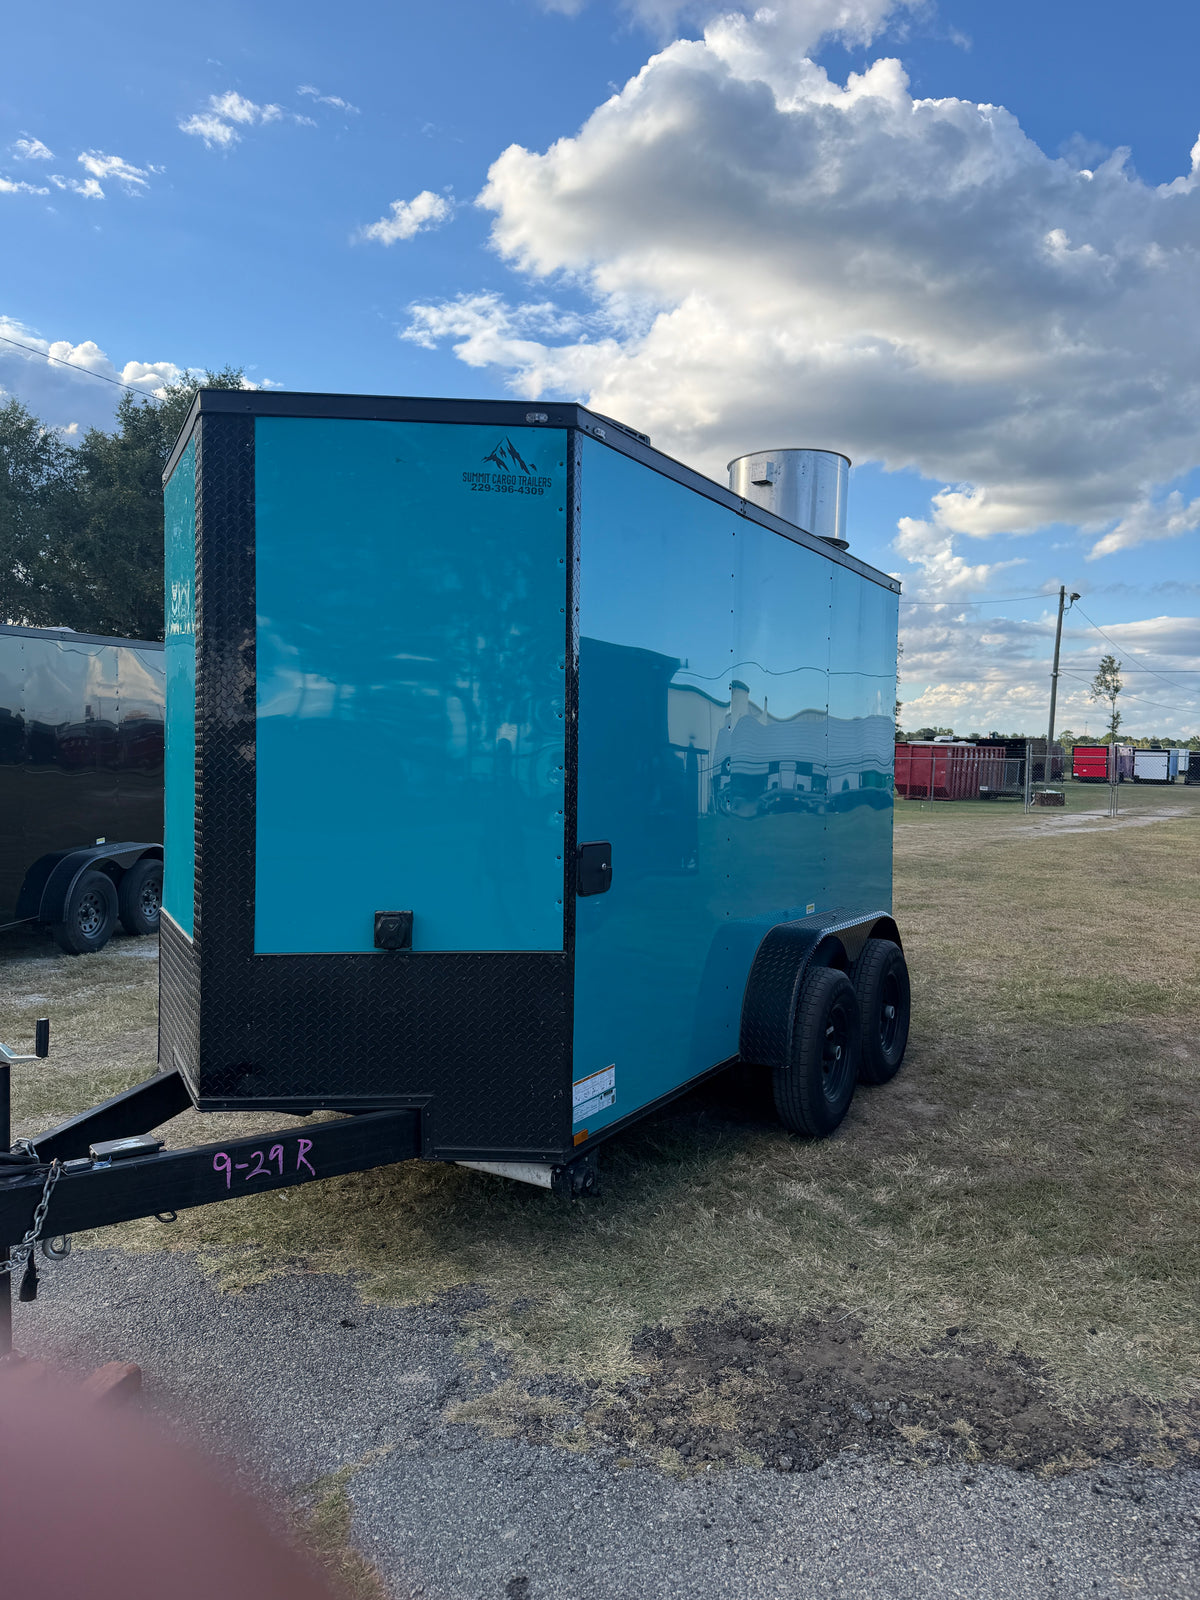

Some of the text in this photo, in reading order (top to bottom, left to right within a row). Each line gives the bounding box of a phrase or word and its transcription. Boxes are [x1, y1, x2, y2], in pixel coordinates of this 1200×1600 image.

[462, 471, 552, 488] SUMMIT CARGO TRAILERS
[471, 483, 544, 496] 229-396-4309
[212, 1138, 316, 1190] 9-29 R
